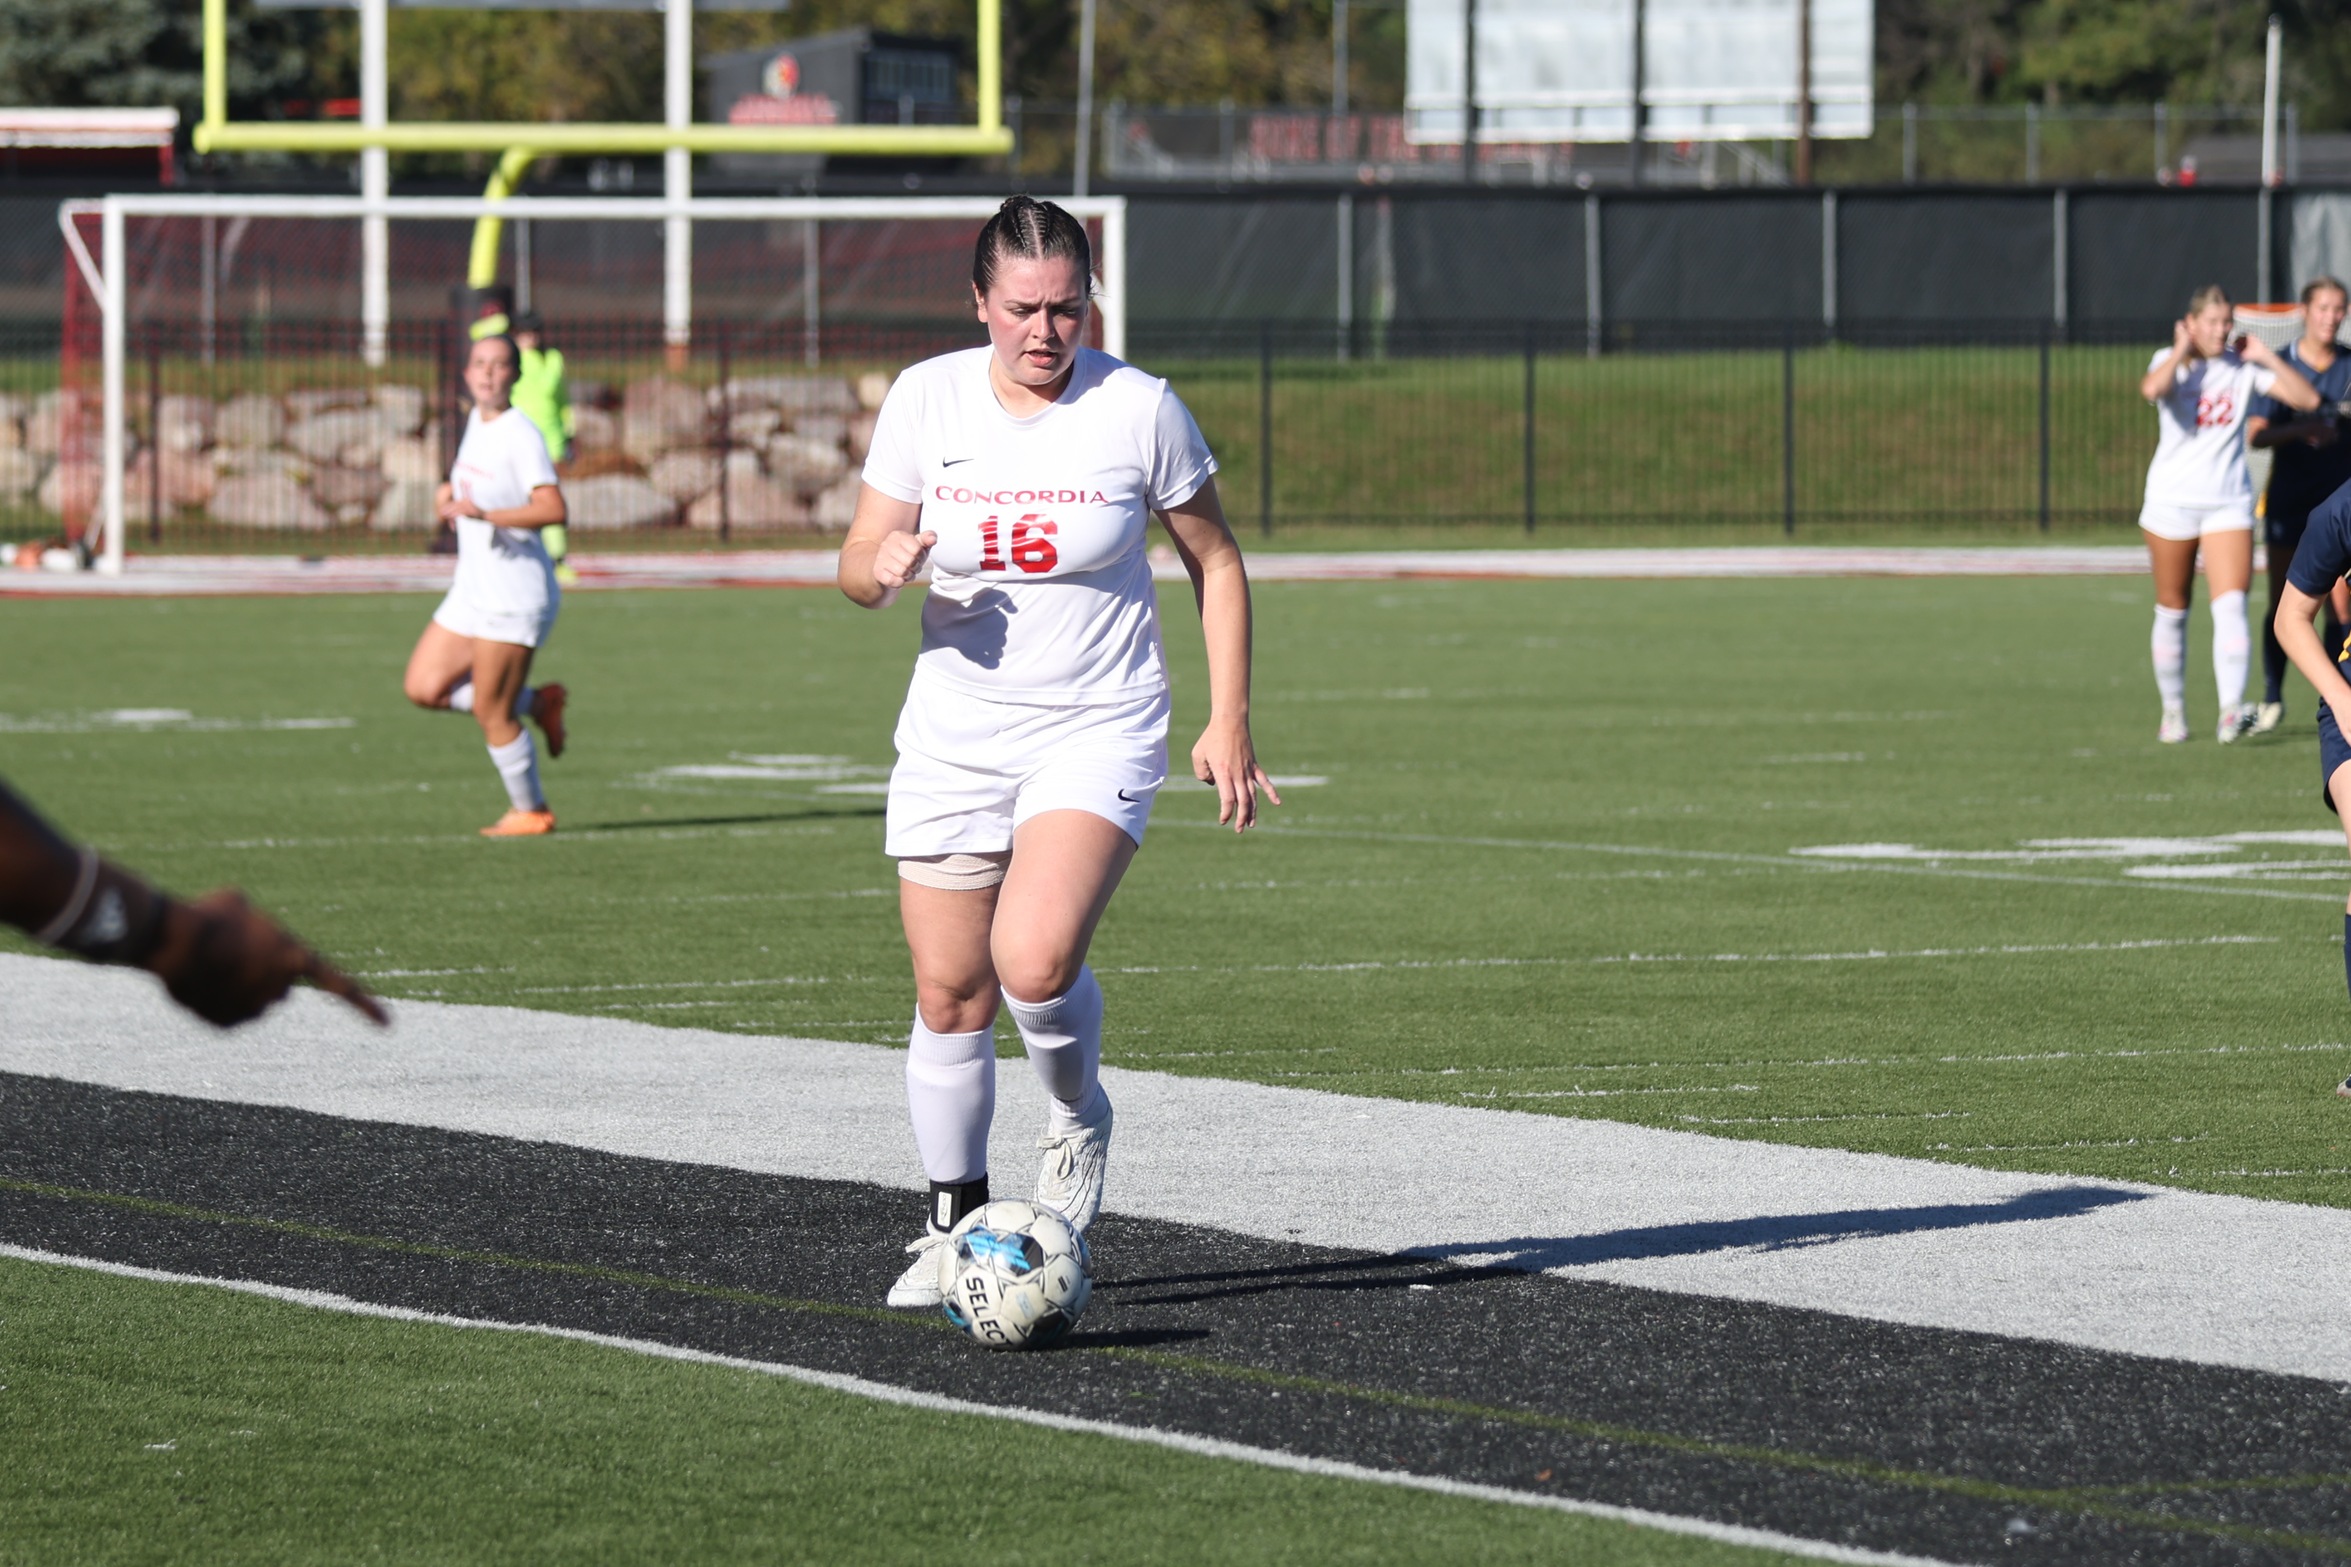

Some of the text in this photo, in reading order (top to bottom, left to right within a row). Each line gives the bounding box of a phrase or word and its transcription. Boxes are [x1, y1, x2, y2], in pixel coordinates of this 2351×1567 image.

[2197, 397, 2234, 427] 22
[935, 485, 1109, 505] CONCORDIA
[978, 513, 1058, 573] 16
